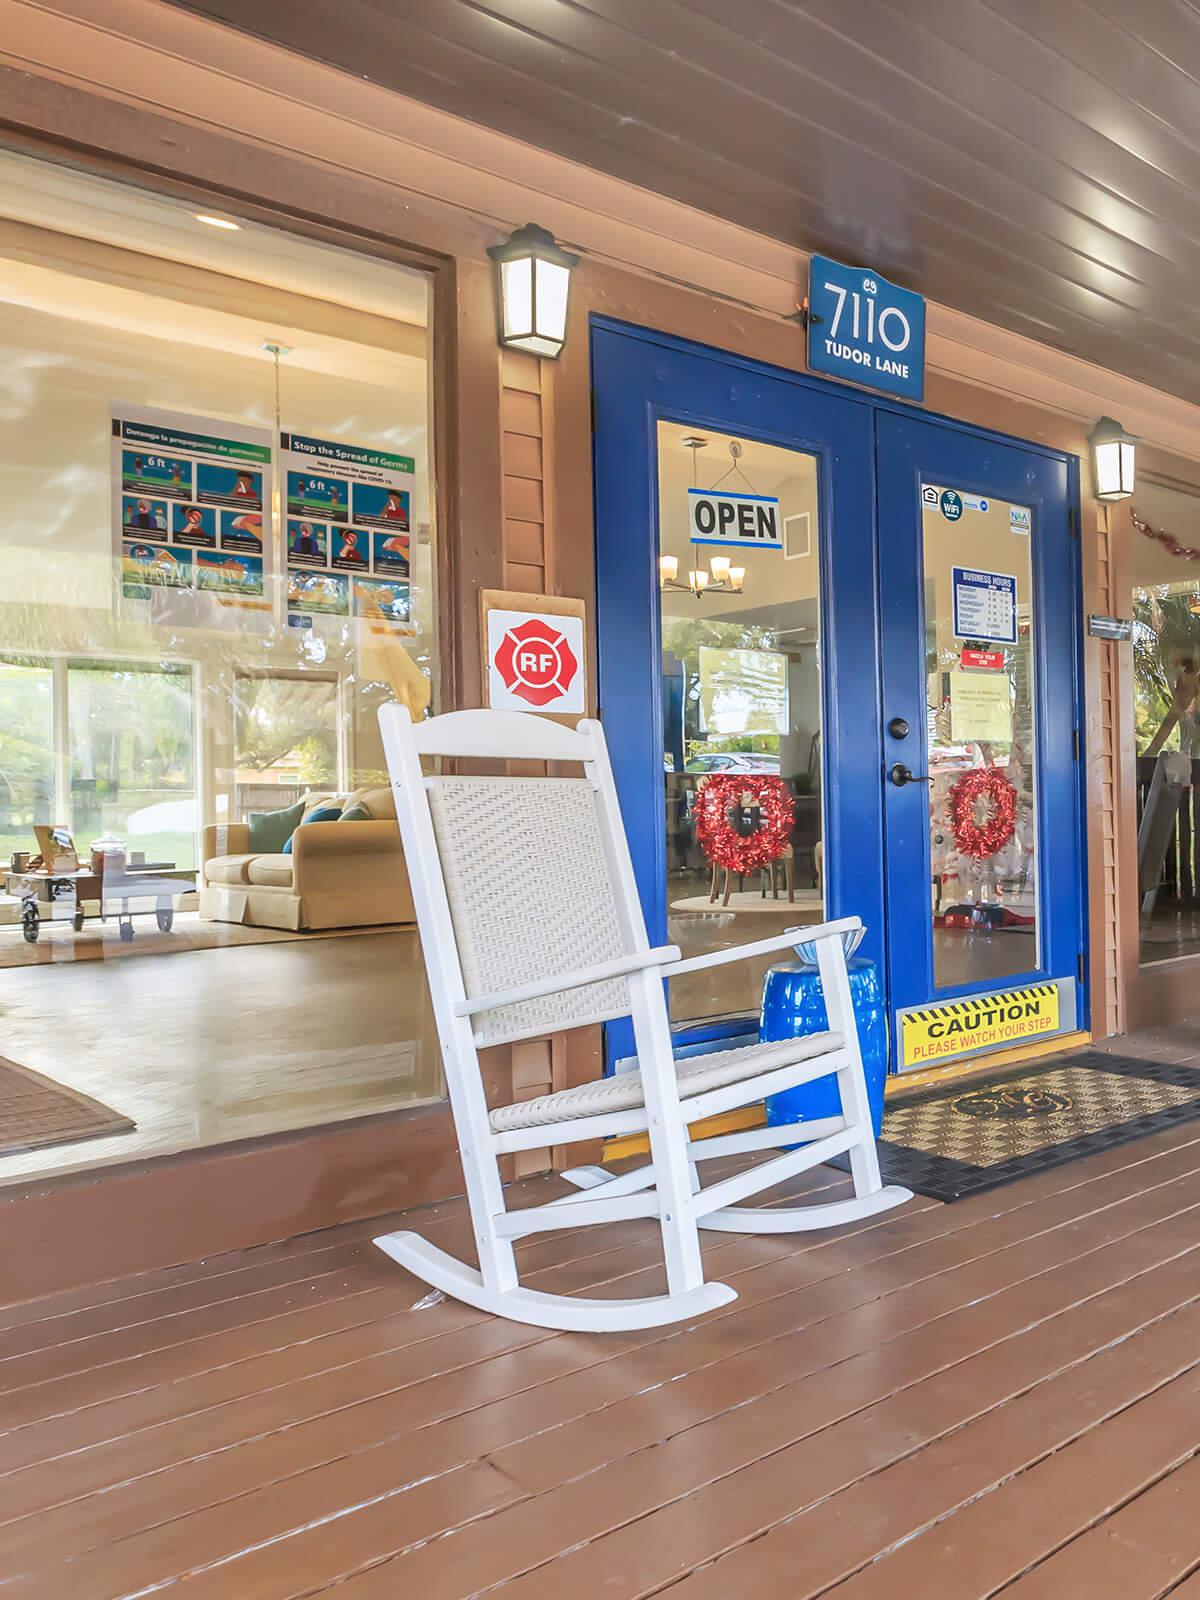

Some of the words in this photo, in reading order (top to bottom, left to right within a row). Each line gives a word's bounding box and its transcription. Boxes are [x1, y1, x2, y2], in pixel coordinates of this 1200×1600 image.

[824, 282, 911, 352] 7110
[824, 339, 872, 368] TUDOR
[875, 356, 910, 379] LANE
[148, 456, 155, 466] 6
[157, 457, 165, 468] ft
[293, 441, 317, 453] Stop
[318, 445, 333, 456] the
[335, 449, 368, 463] Spread
[369, 455, 379, 464] of
[380, 458, 408, 470] Germs
[309, 480, 316, 489] 6
[317, 481, 325, 490] ft
[695, 500, 777, 539] OPEN
[963, 571, 991, 584] BUSINESS
[992, 576, 1011, 587] HOURS
[520, 652, 553, 672] RF
[927, 1001, 1040, 1038] CAUTION
[913, 1040, 957, 1059] PLEASE
[959, 1030, 996, 1049] WATCH
[999, 1022, 1026, 1038] YOUR
[1028, 1016, 1052, 1032] STEP
